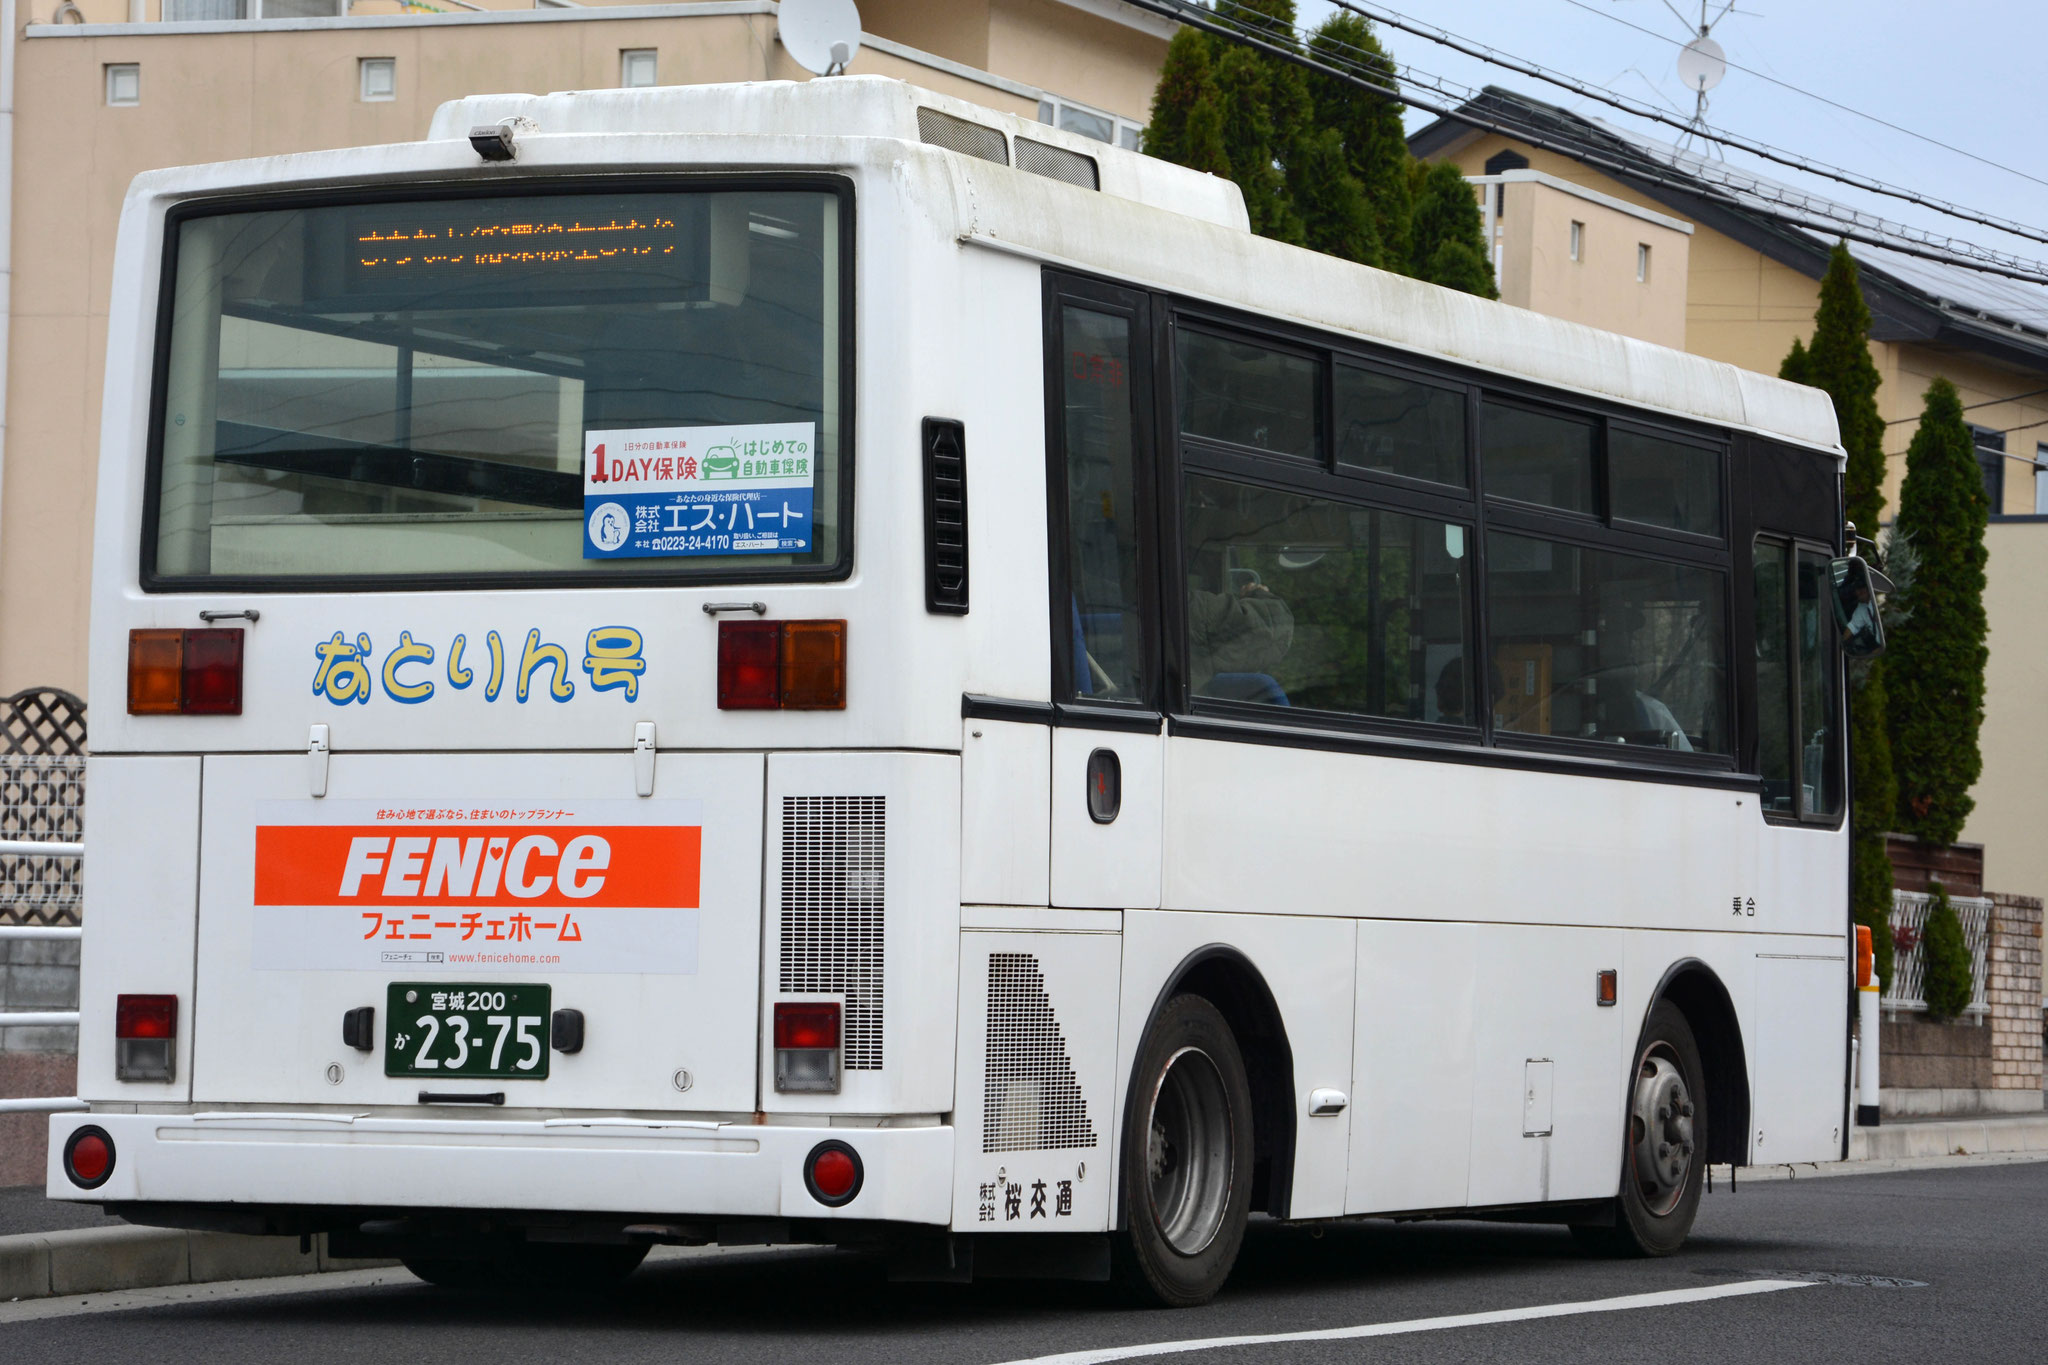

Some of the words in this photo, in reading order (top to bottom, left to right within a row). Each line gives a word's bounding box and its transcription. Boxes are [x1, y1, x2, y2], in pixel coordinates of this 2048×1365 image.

[624, 441, 687, 451] 1日分の自動車保険
[743, 440, 808, 456] はじめての
[743, 458, 808, 476] 自動車保険
[663, 501, 803, 532] エス・ハート
[635, 540, 650, 548] 本社
[661, 535, 729, 551] 0223-24-4170
[312, 625, 647, 706] なとりん号
[376, 809, 575, 821] 住み心地で選ぶなら、住まいのトップランナー
[1732, 896, 1756, 917] 乗合
[361, 912, 583, 942] フェニーチェホーム
[448, 952, 561, 964] www.fenicehome.com
[394, 1033, 410, 1050] か
[414, 1015, 542, 1070] 23-75
[1004, 1178, 1072, 1221] 桜交通
